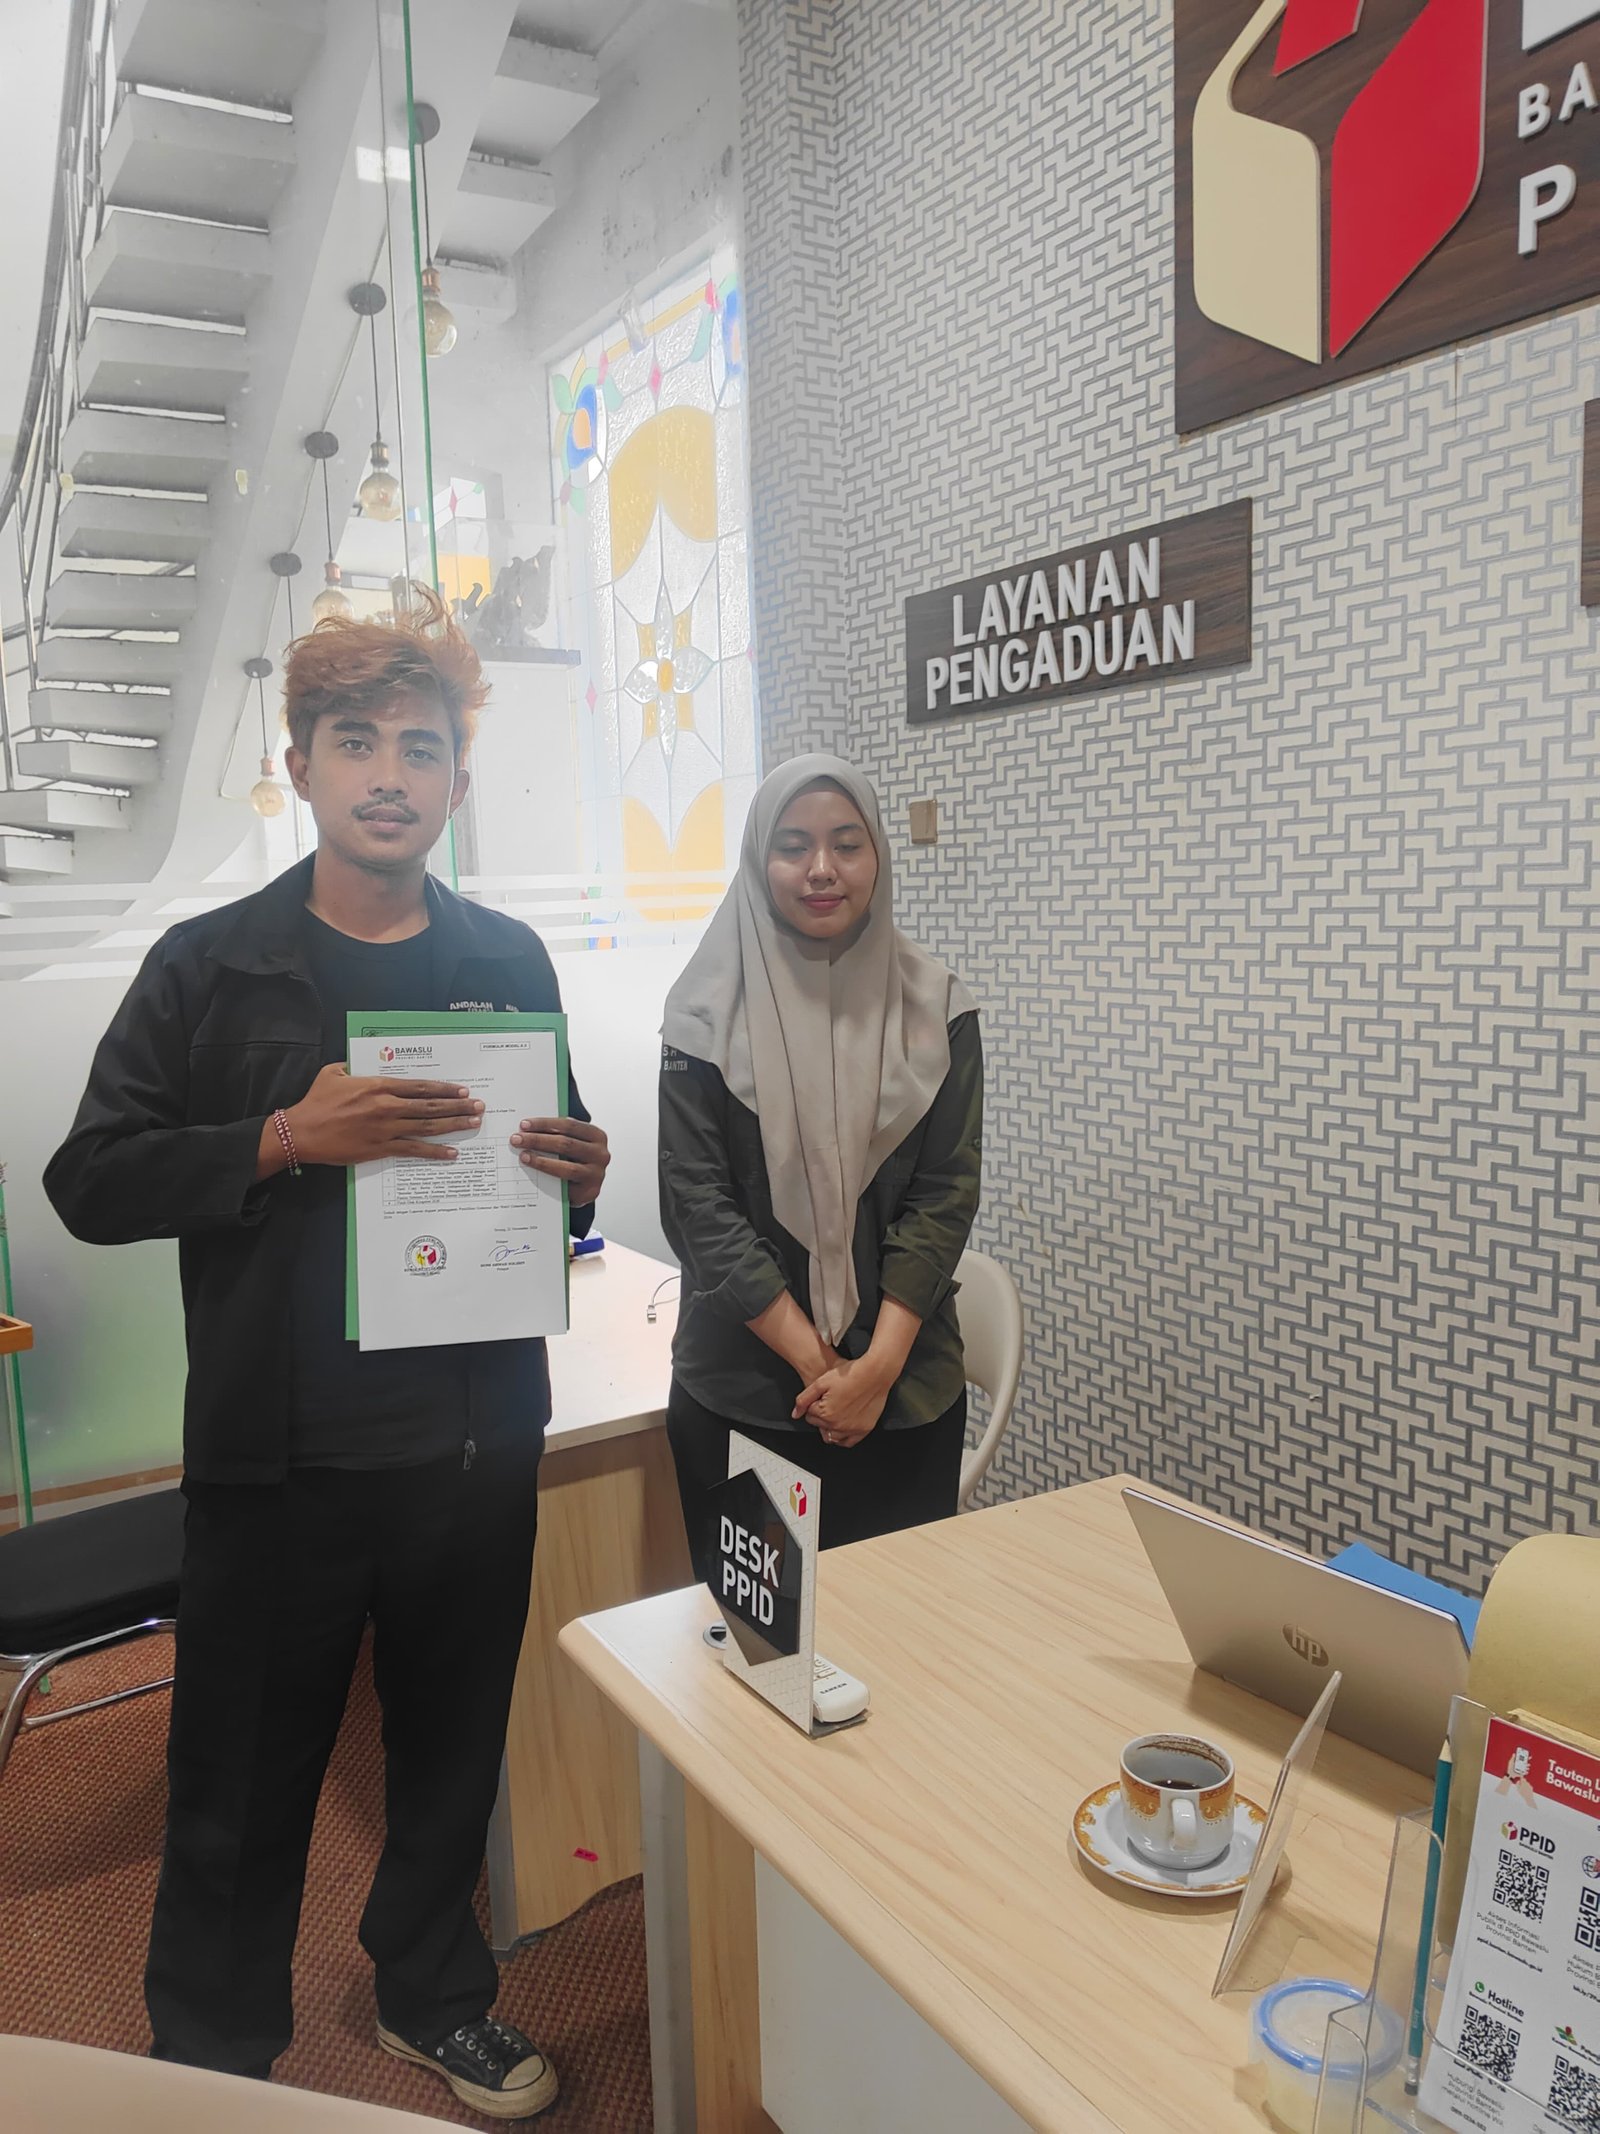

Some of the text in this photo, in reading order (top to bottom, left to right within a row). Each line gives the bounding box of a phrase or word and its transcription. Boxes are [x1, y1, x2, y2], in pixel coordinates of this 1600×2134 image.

[1518, 61, 1599, 138] BA
[1517, 164, 1576, 254] P
[953, 537, 1161, 647] LAYANAN
[926, 600, 1196, 710] PENGADUAN
[449, 1001, 494, 1011] ANDALAN
[394, 1046, 433, 1054] BAWASLU
[664, 1060, 688, 1071] BANTEN
[720, 1515, 779, 1588] DESK
[722, 1560, 774, 1626] PPID
[1291, 1625, 1322, 1664] hp
[1546, 1771, 1600, 1803] Bawaslu
[1548, 1759, 1592, 1787] Tautan
[1519, 1826, 1556, 1854] PPID
[1488, 1989, 1525, 2017] Hotline
